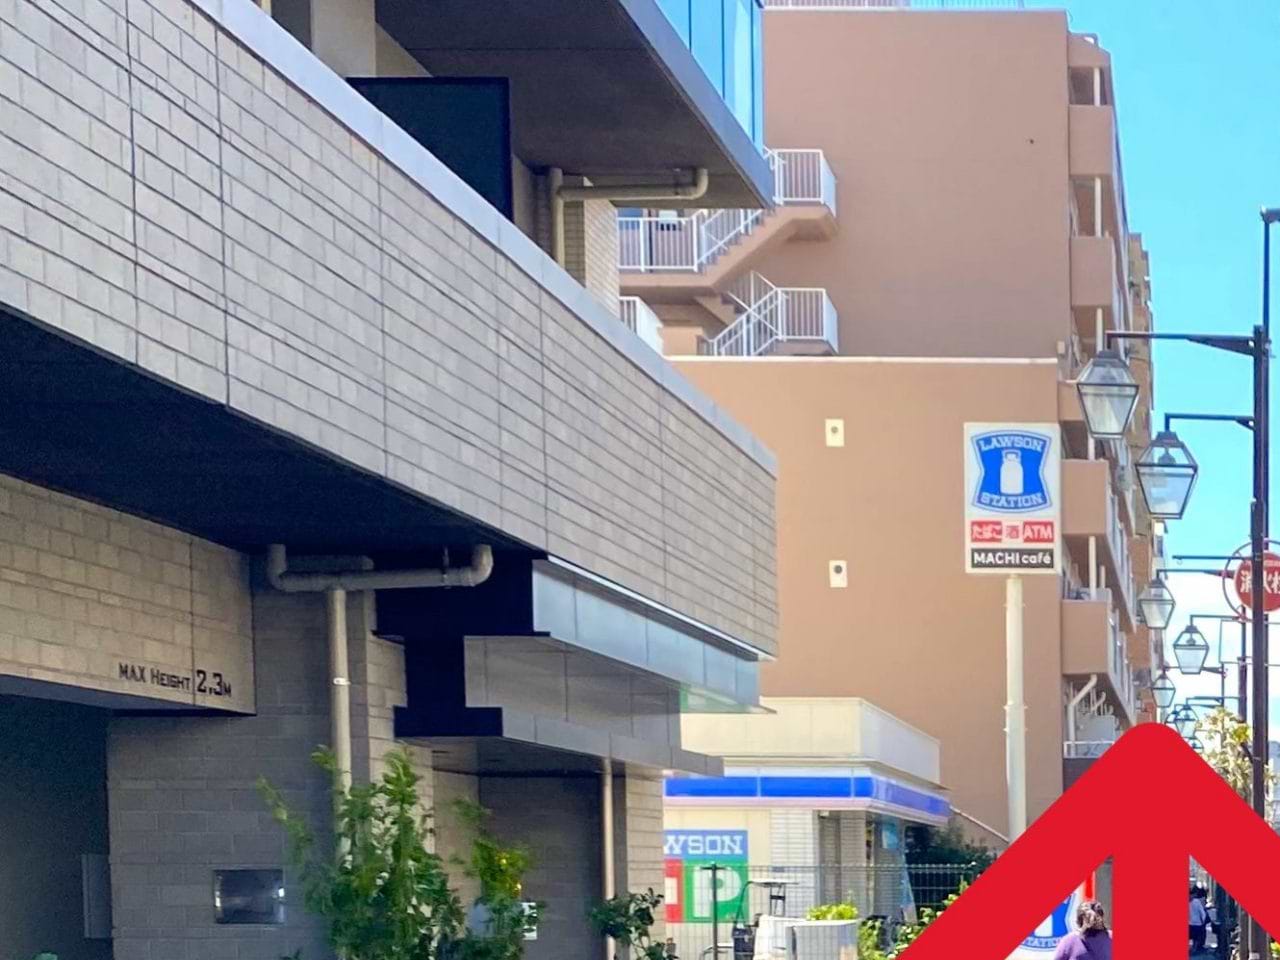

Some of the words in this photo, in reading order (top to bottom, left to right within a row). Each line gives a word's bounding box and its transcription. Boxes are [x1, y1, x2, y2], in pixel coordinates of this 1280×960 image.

[979, 435, 1044, 452] LAWSON
[980, 491, 1043, 508] STATION
[972, 523, 1001, 540] たばこ
[1024, 525, 1052, 539] ATM
[973, 552, 1019, 564] MACHI
[1021, 551, 1051, 564] café
[119, 662, 146, 683] MAX
[663, 834, 744, 855] WSON
[693, 865, 742, 918] P
